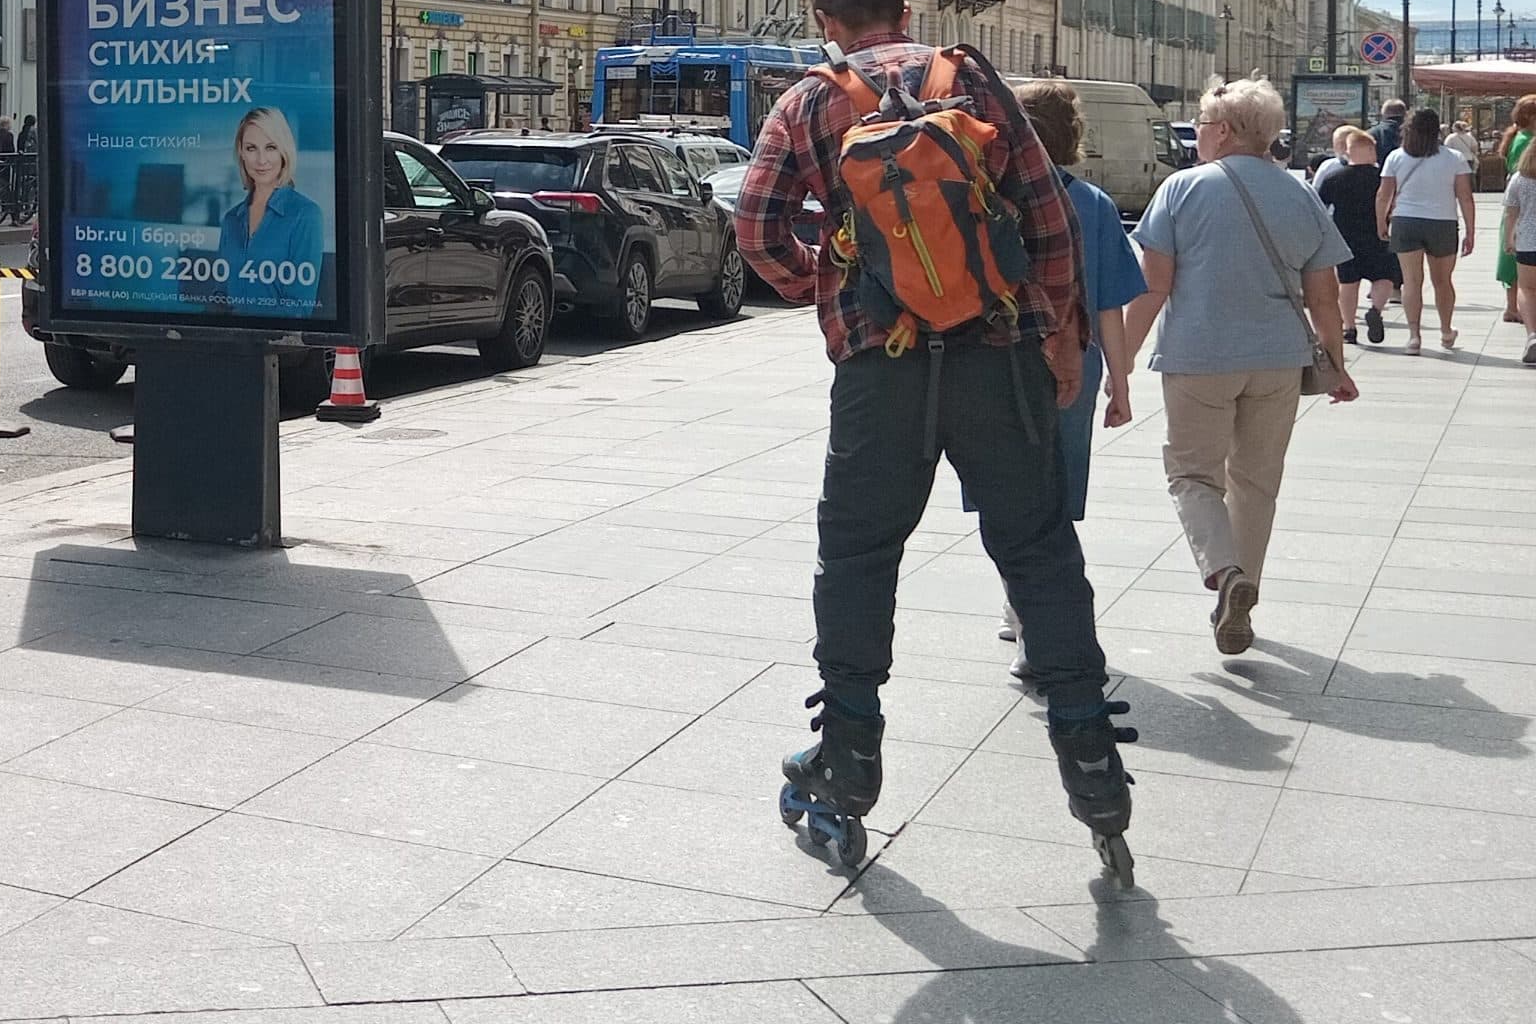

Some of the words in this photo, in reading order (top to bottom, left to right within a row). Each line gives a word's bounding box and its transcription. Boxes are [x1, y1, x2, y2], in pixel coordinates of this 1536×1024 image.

[87, 38, 217, 67] СТИХИЯ
[703, 69, 717, 82] 22
[87, 76, 253, 106] СИЛЬНЫХ
[87, 132, 134, 149] Наша
[138, 132, 201, 149] стихия!
[74, 225, 127, 243] bbr.ru
[141, 227, 206, 249] ббр.рф
[76, 253, 92, 277] 8
[100, 254, 153, 279] 800
[160, 256, 230, 283] 2200
[238, 259, 316, 286] 4000
[88, 289, 111, 298] БАНК
[111, 289, 130, 300] (АО)
